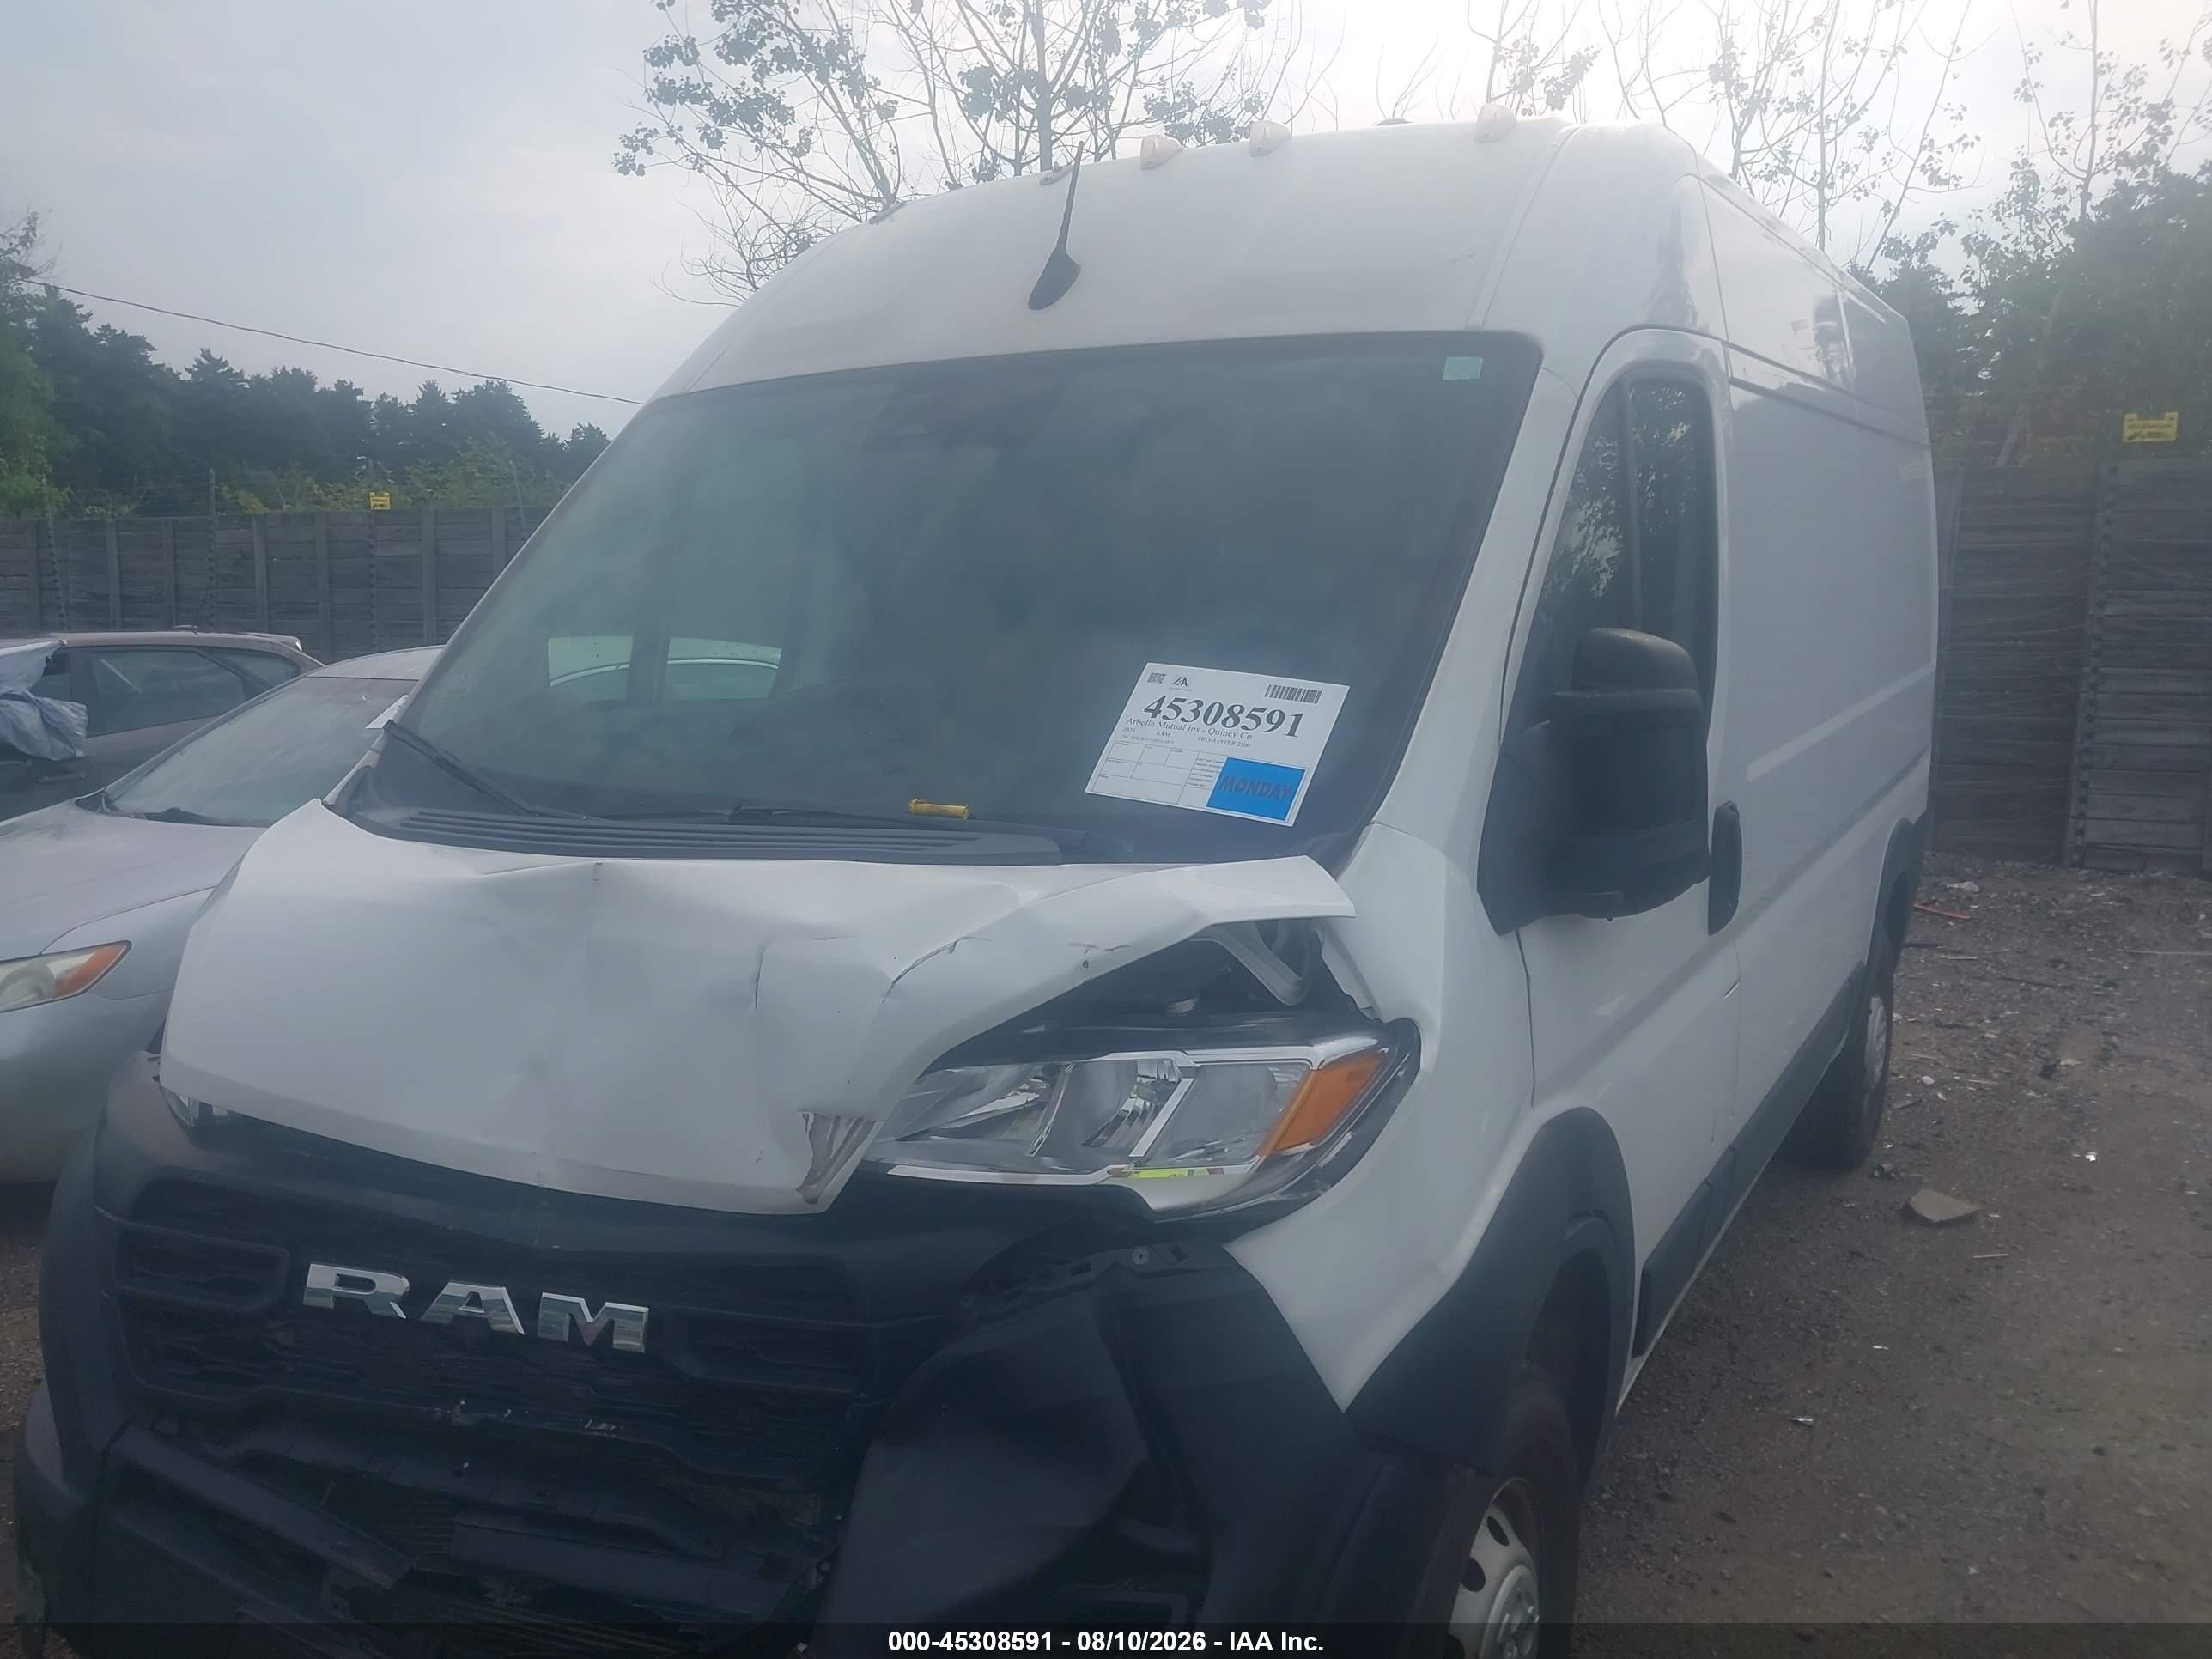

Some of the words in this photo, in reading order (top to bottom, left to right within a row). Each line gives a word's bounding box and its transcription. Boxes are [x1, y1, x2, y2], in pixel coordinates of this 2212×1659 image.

[1126, 718, 1155, 727] Arbella
[1157, 720, 1187, 731] Mutual
[1208, 727, 1237, 739] Quincy
[1240, 732, 1252, 740] Co
[1142, 695, 1306, 738] 45308591
[1218, 775, 1292, 801] MONDAY
[303, 1263, 649, 1353] RAM
